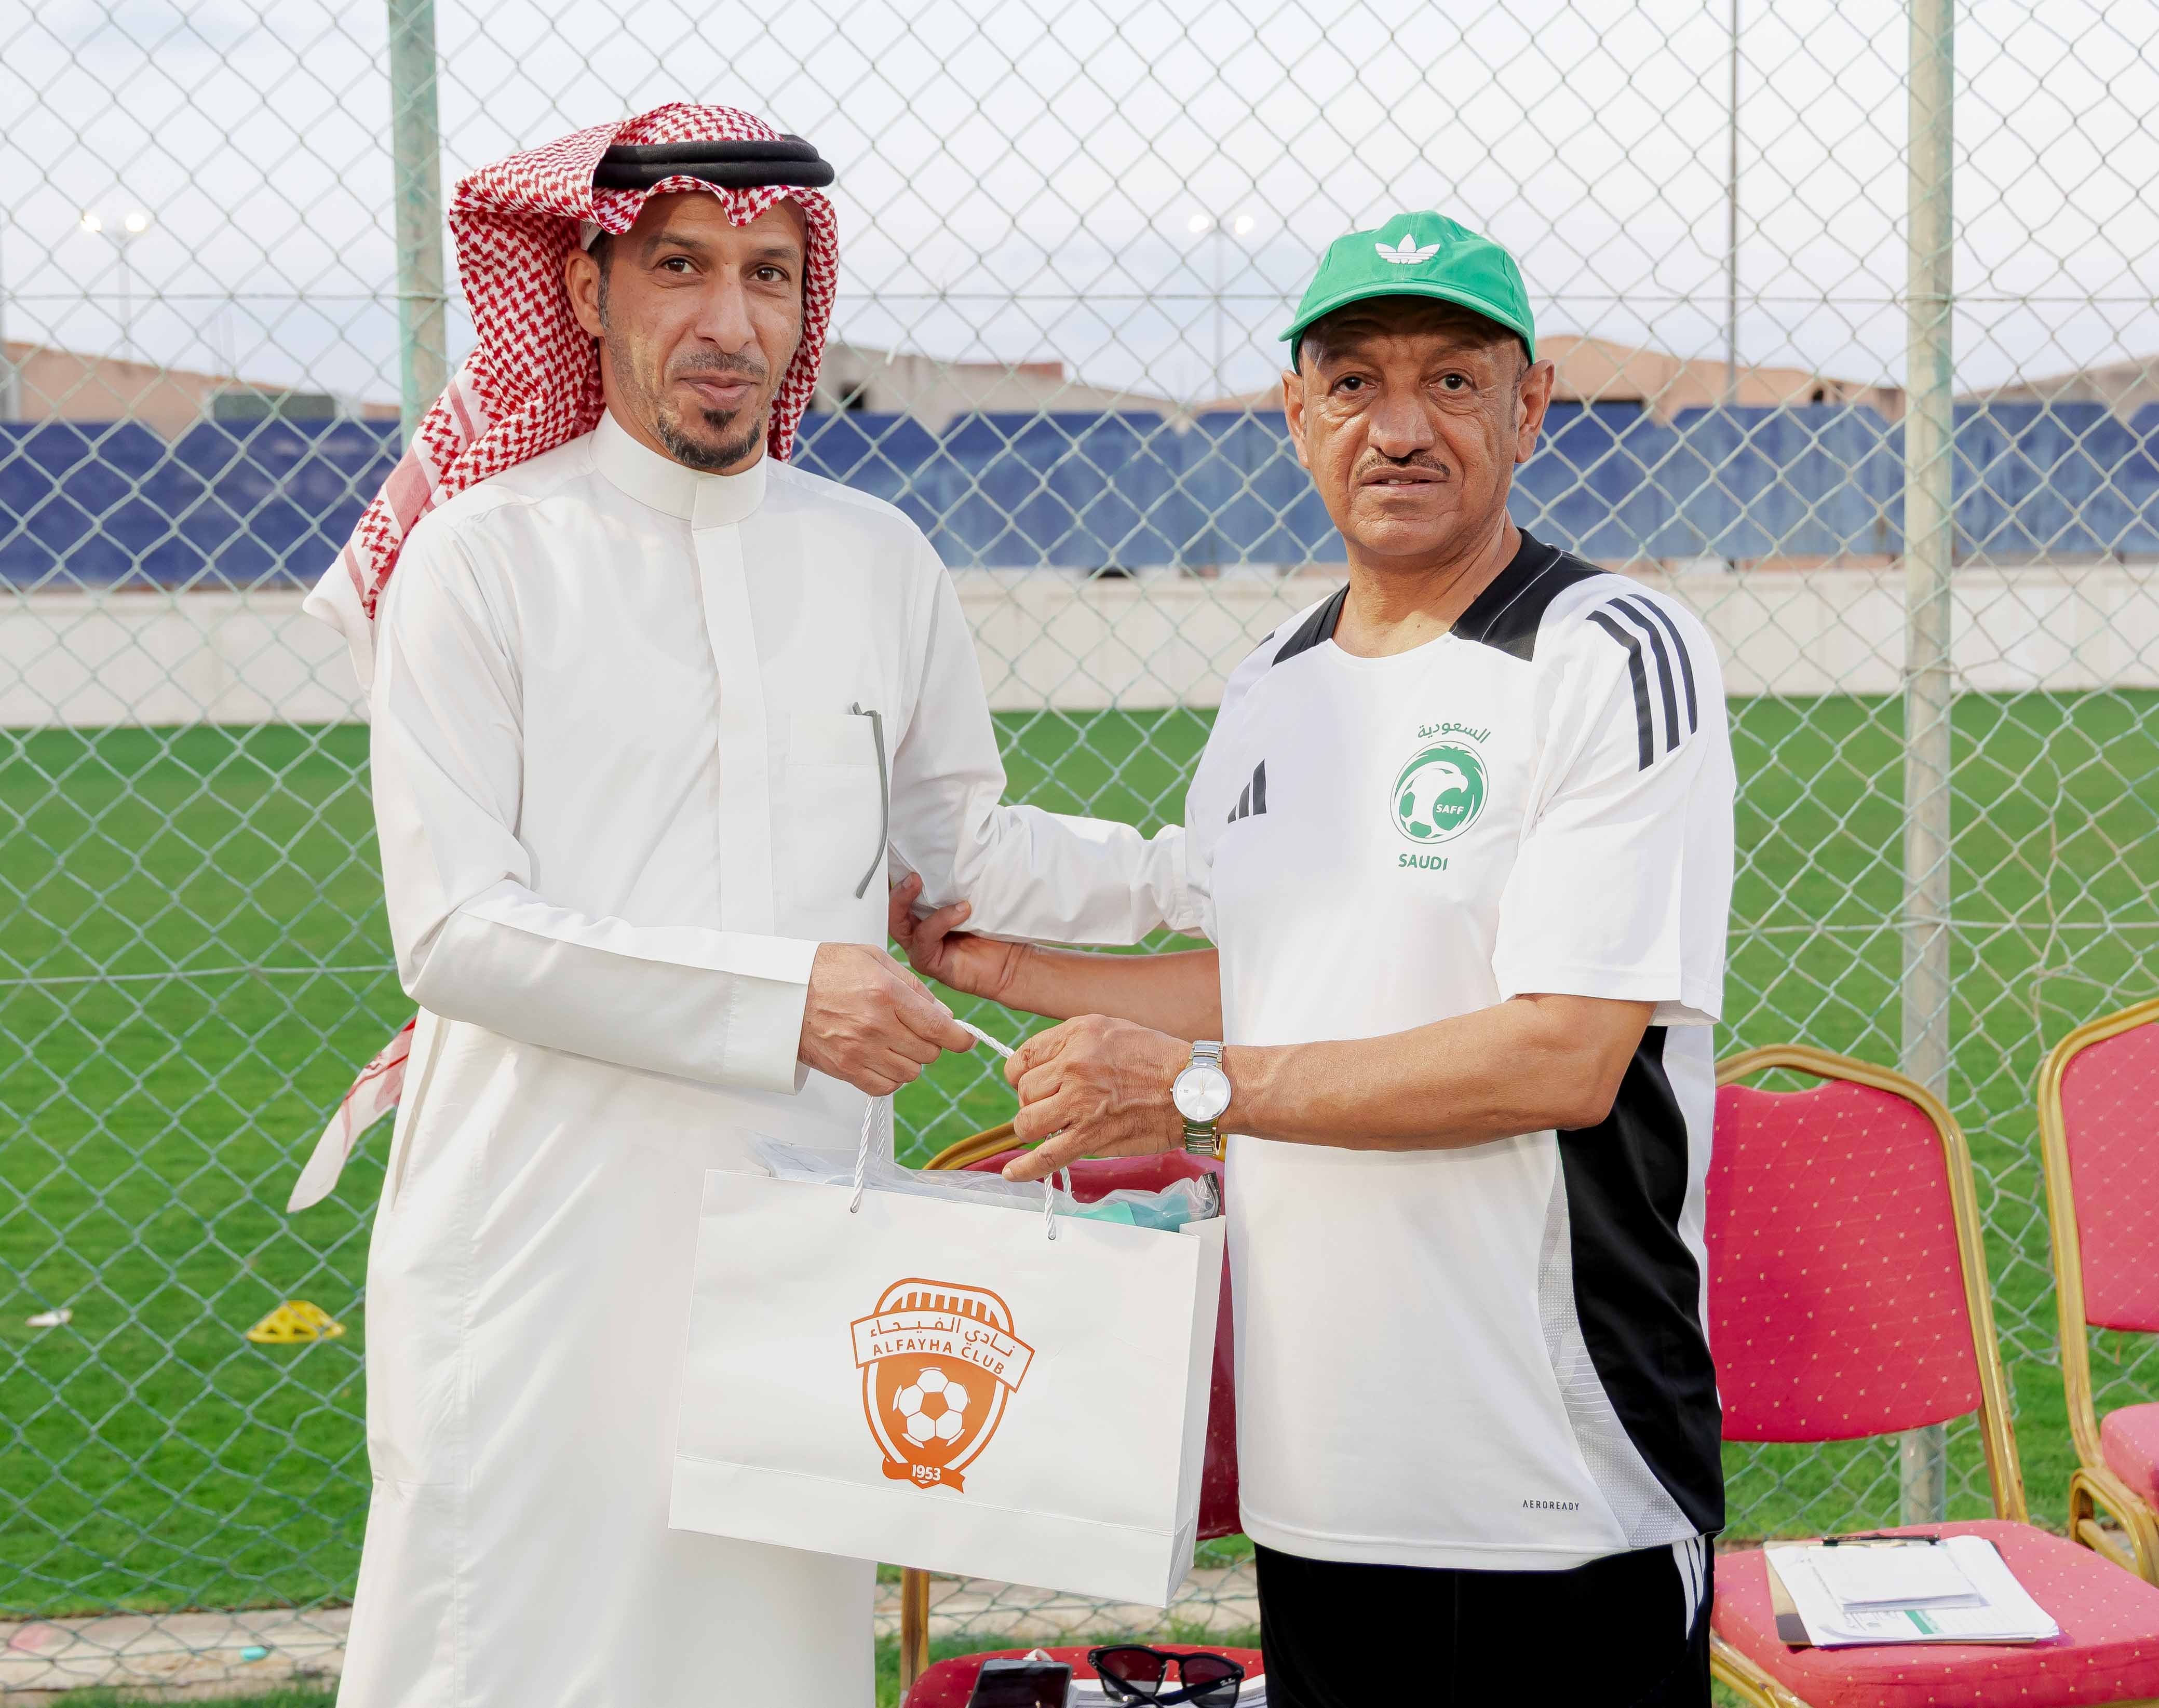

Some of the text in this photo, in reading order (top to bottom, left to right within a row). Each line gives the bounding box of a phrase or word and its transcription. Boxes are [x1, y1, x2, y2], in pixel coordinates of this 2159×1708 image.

[1417, 723, 1491, 743] السعودية
[1435, 804, 1464, 815] SAFF
[1398, 853, 1448, 871] SAUDI
[870, 1317, 1016, 1358] نادي الفيحاء
[873, 1338, 1006, 1375] ALFAYHA CLUB
[912, 1464, 941, 1481] 1953
[1522, 1499, 1579, 1511] AEROREADY
